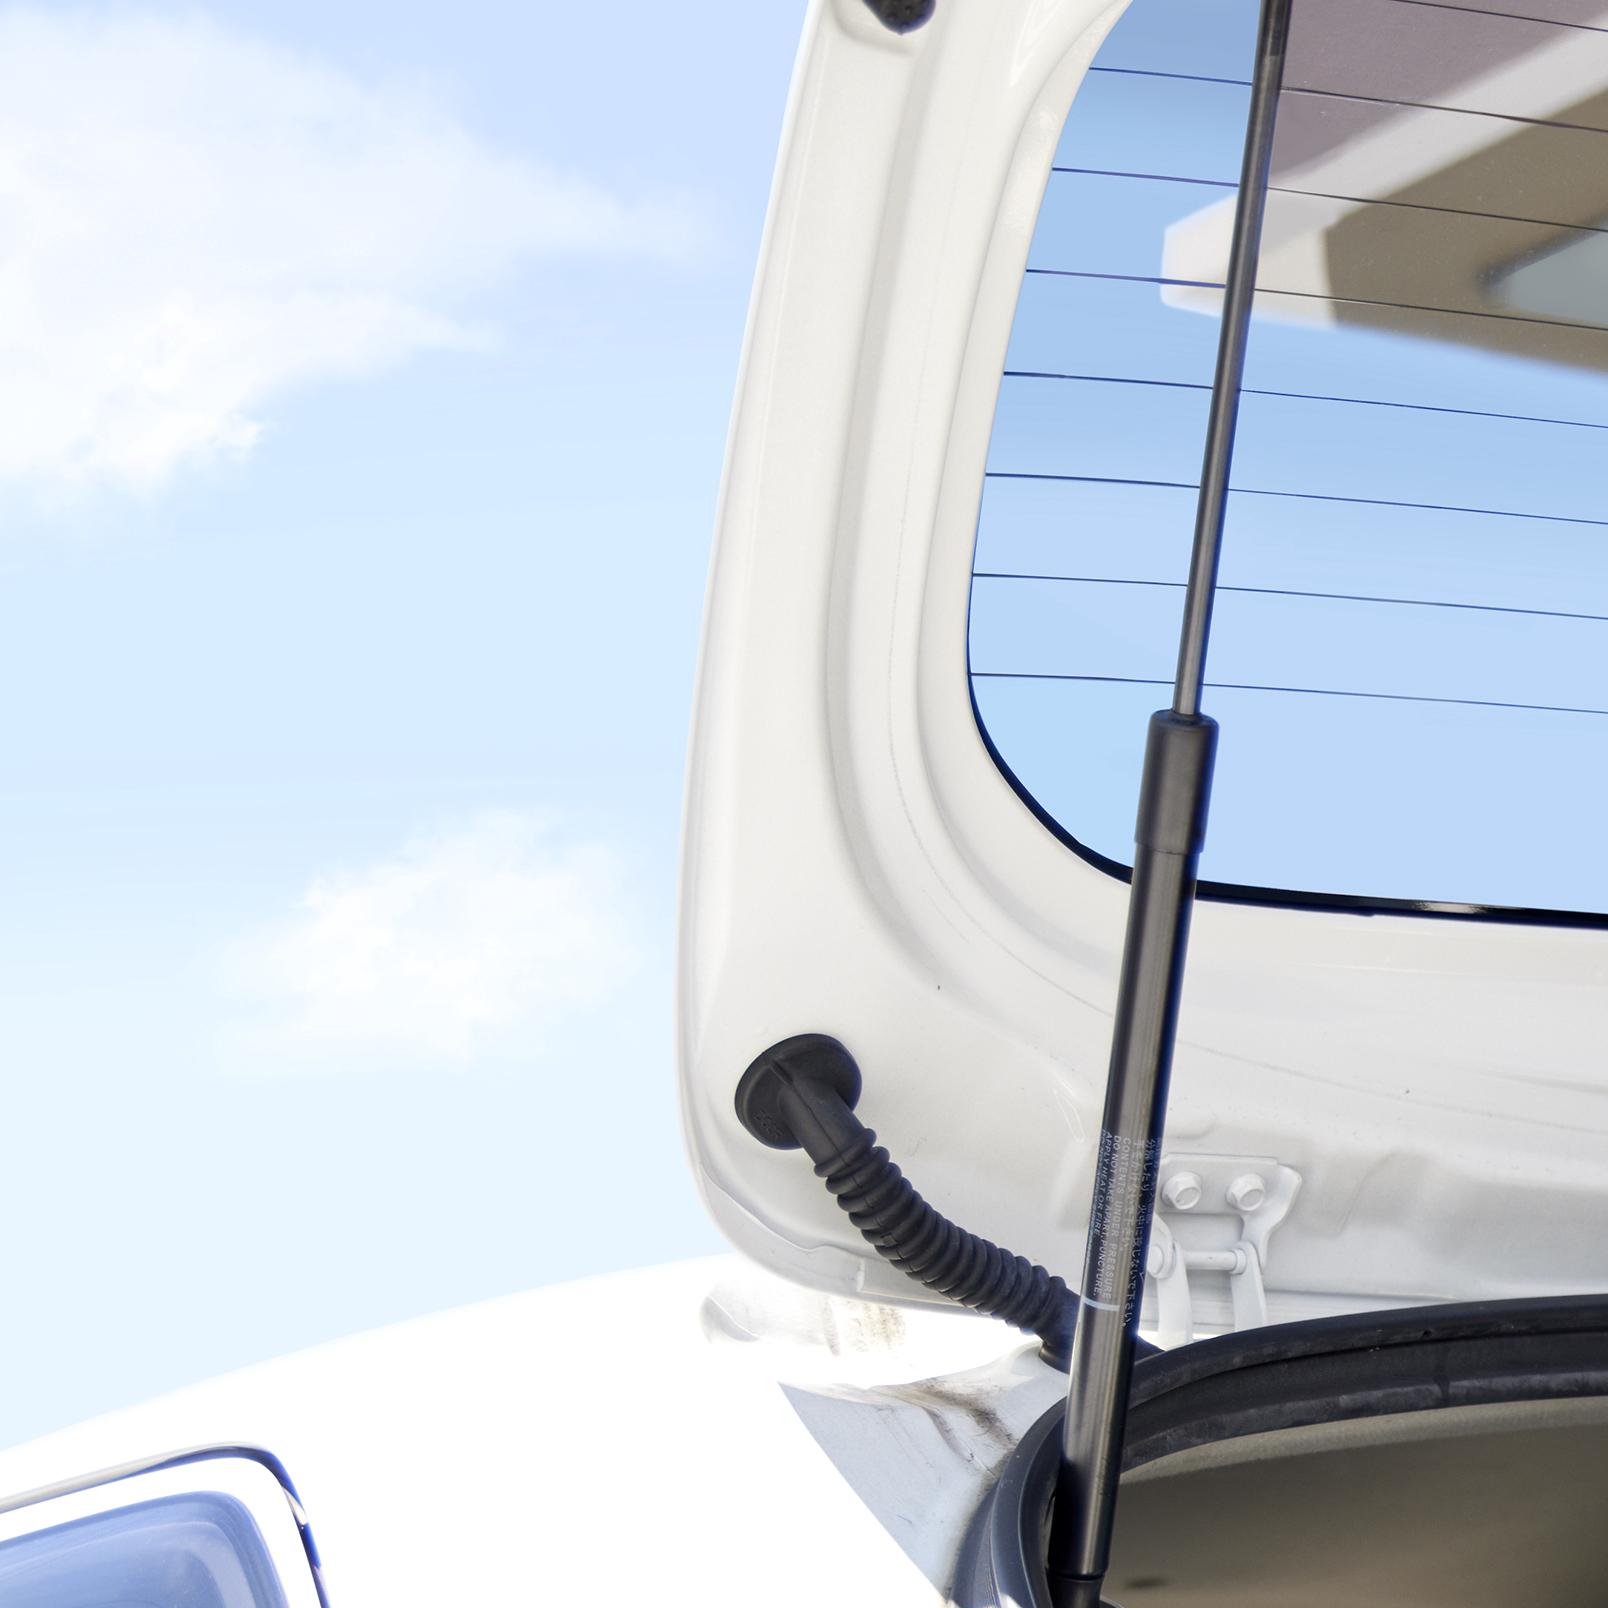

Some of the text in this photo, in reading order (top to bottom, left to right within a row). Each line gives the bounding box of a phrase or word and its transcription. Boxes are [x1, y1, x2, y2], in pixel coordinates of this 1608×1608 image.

[1112, 1134, 1121, 1150] DO
[1108, 1153, 1119, 1174] NOT
[1105, 1177, 1116, 1202] TAKE
[1101, 1136, 1131, 1299] CONTENTS UNDER PRESSURE
